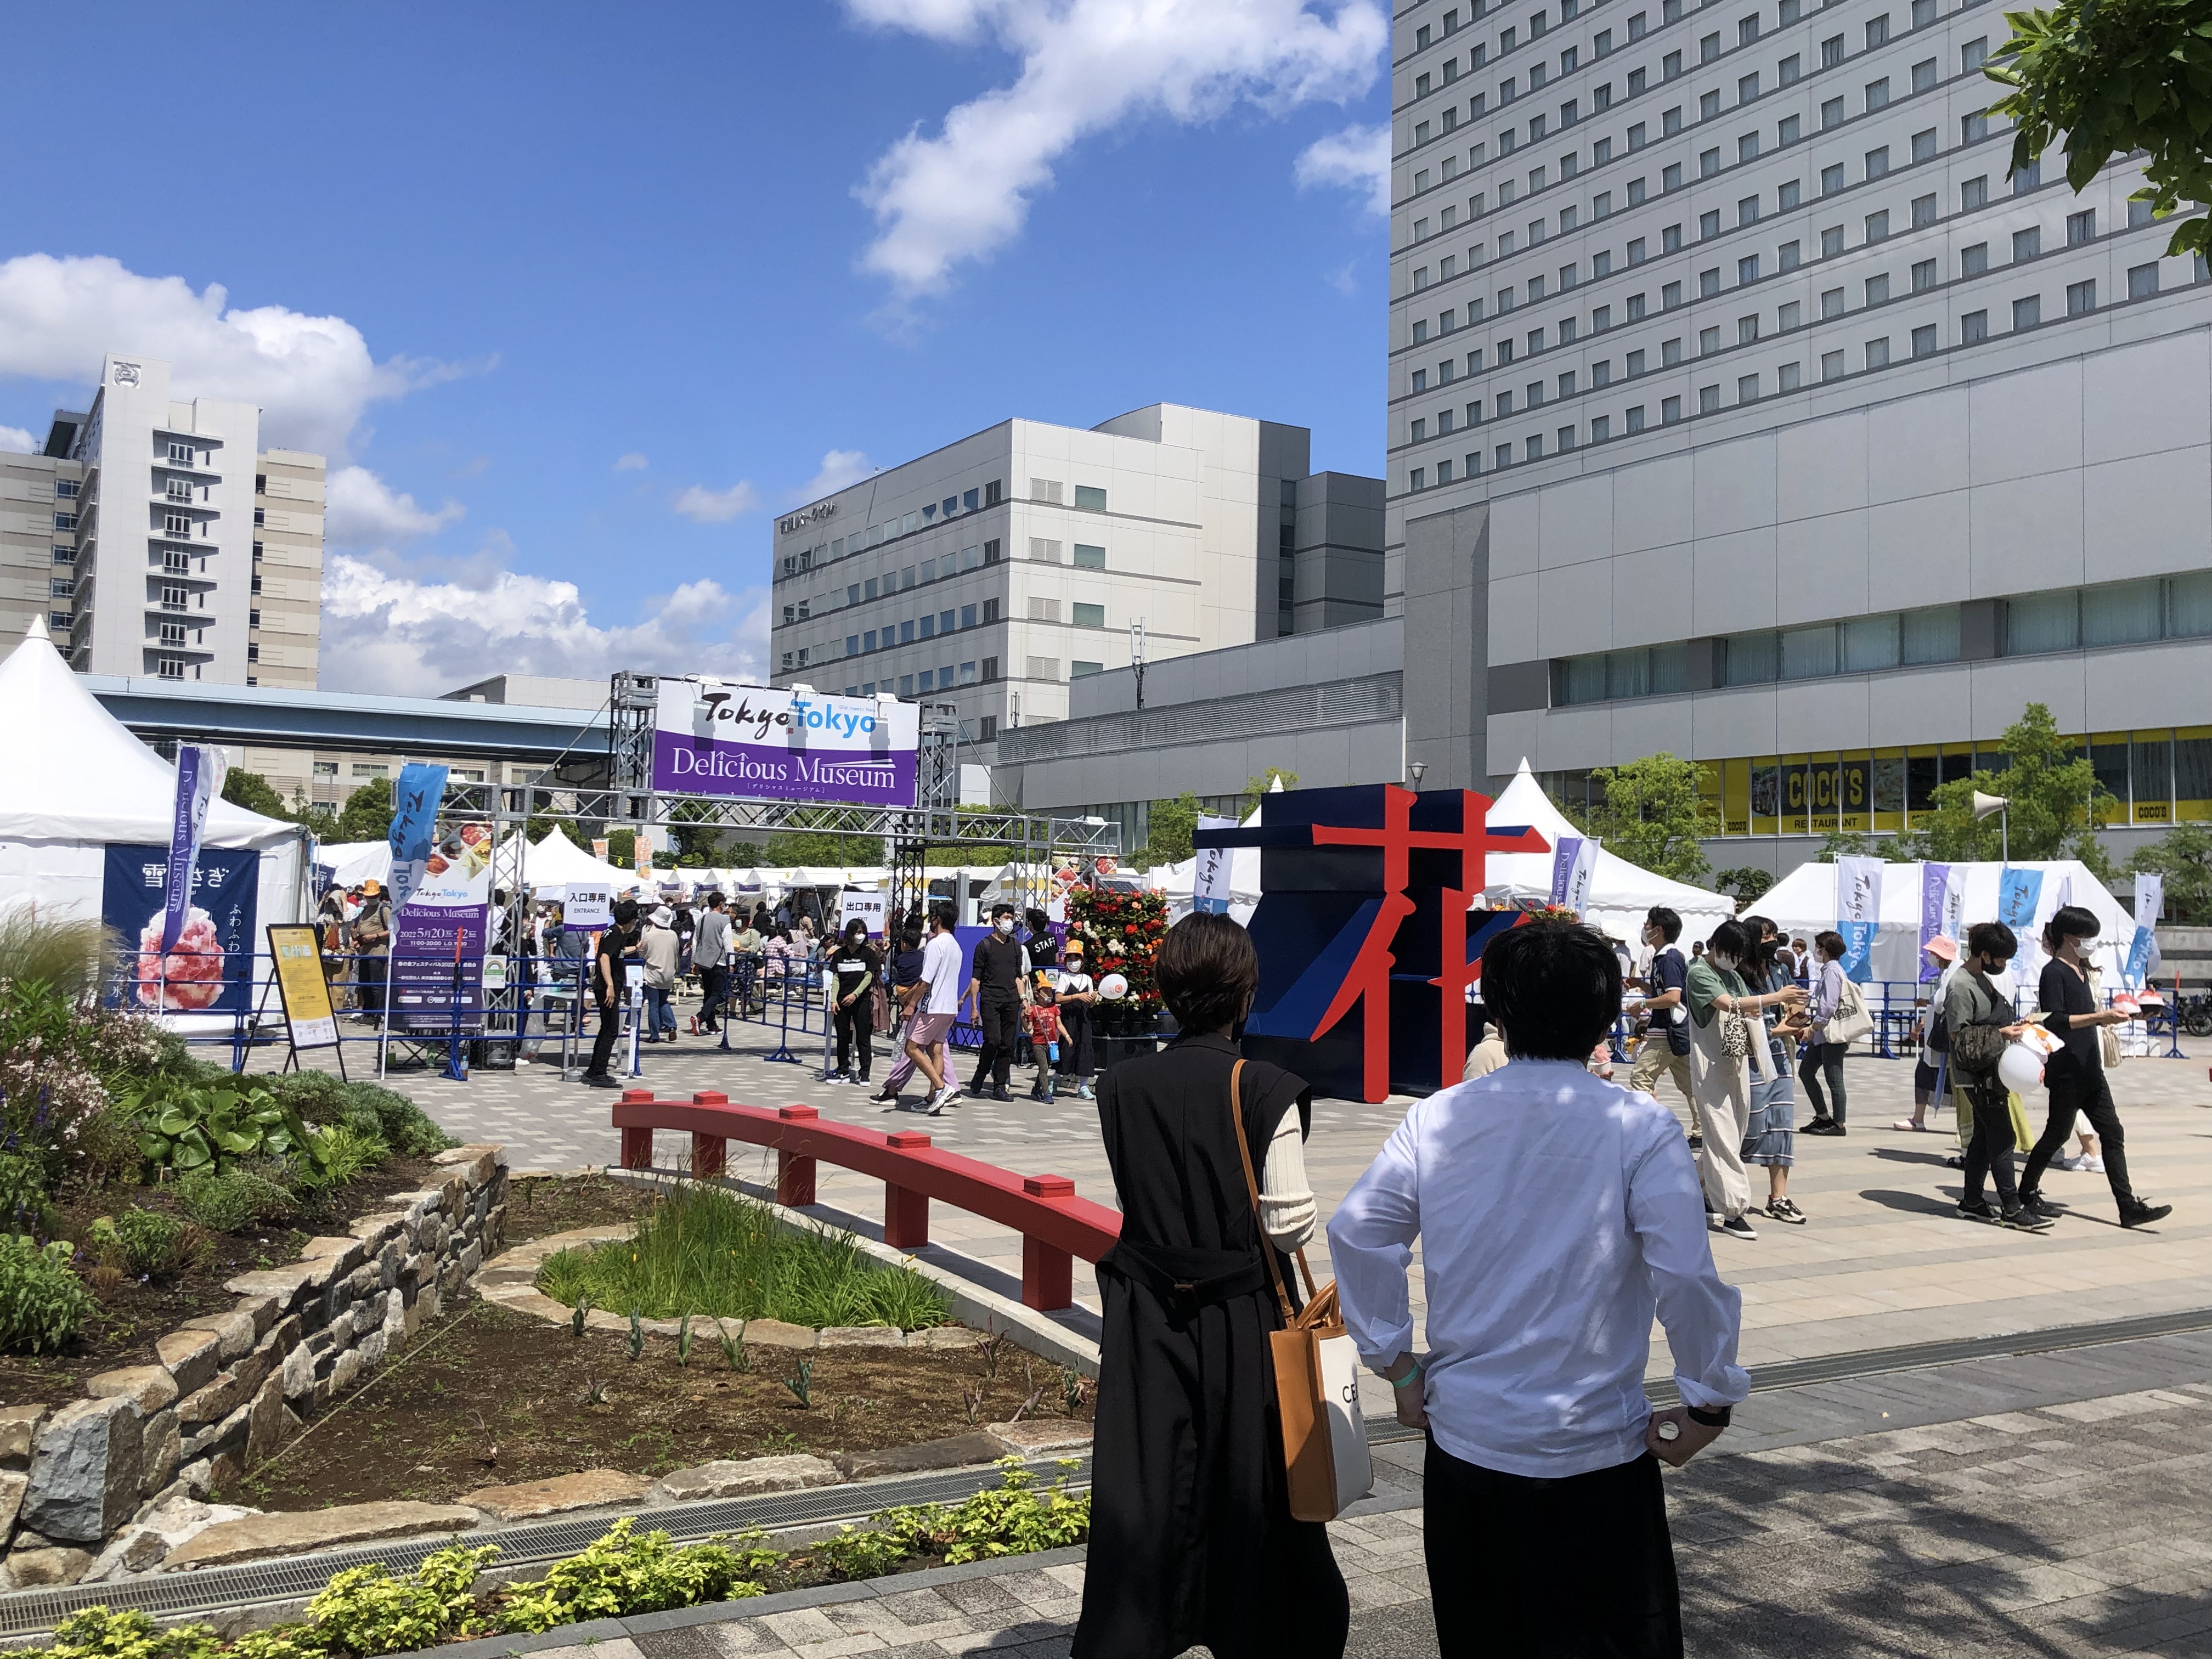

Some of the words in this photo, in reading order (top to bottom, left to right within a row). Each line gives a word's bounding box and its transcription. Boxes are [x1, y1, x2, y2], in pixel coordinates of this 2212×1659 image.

[702, 693, 790, 740] Tokyo
[791, 701, 877, 738] Tokyo
[672, 747, 787, 782] Delicious
[794, 755, 896, 788] Museum
[1789, 768, 1863, 809] COCO'S
[392, 790, 425, 858] Tokyo
[416, 888, 442, 900] Tokyo
[442, 889, 469, 899] Tokyo
[1557, 853, 1570, 900] Delicious
[1571, 869, 1587, 901] Tokyo
[401, 908, 441, 917] Delicious
[443, 908, 479, 918] Museum
[569, 893, 606, 903] 入口専用
[846, 901, 881, 912] 出口専用
[1846, 875, 1870, 920] Tokyo
[1946, 893, 1960, 920] Tokyo
[2004, 884, 2029, 926] Tokyo
[228, 904, 241, 952] ふわふわ
[1035, 937, 1056, 953] STAFF
[1847, 924, 1867, 968] Tokyo
